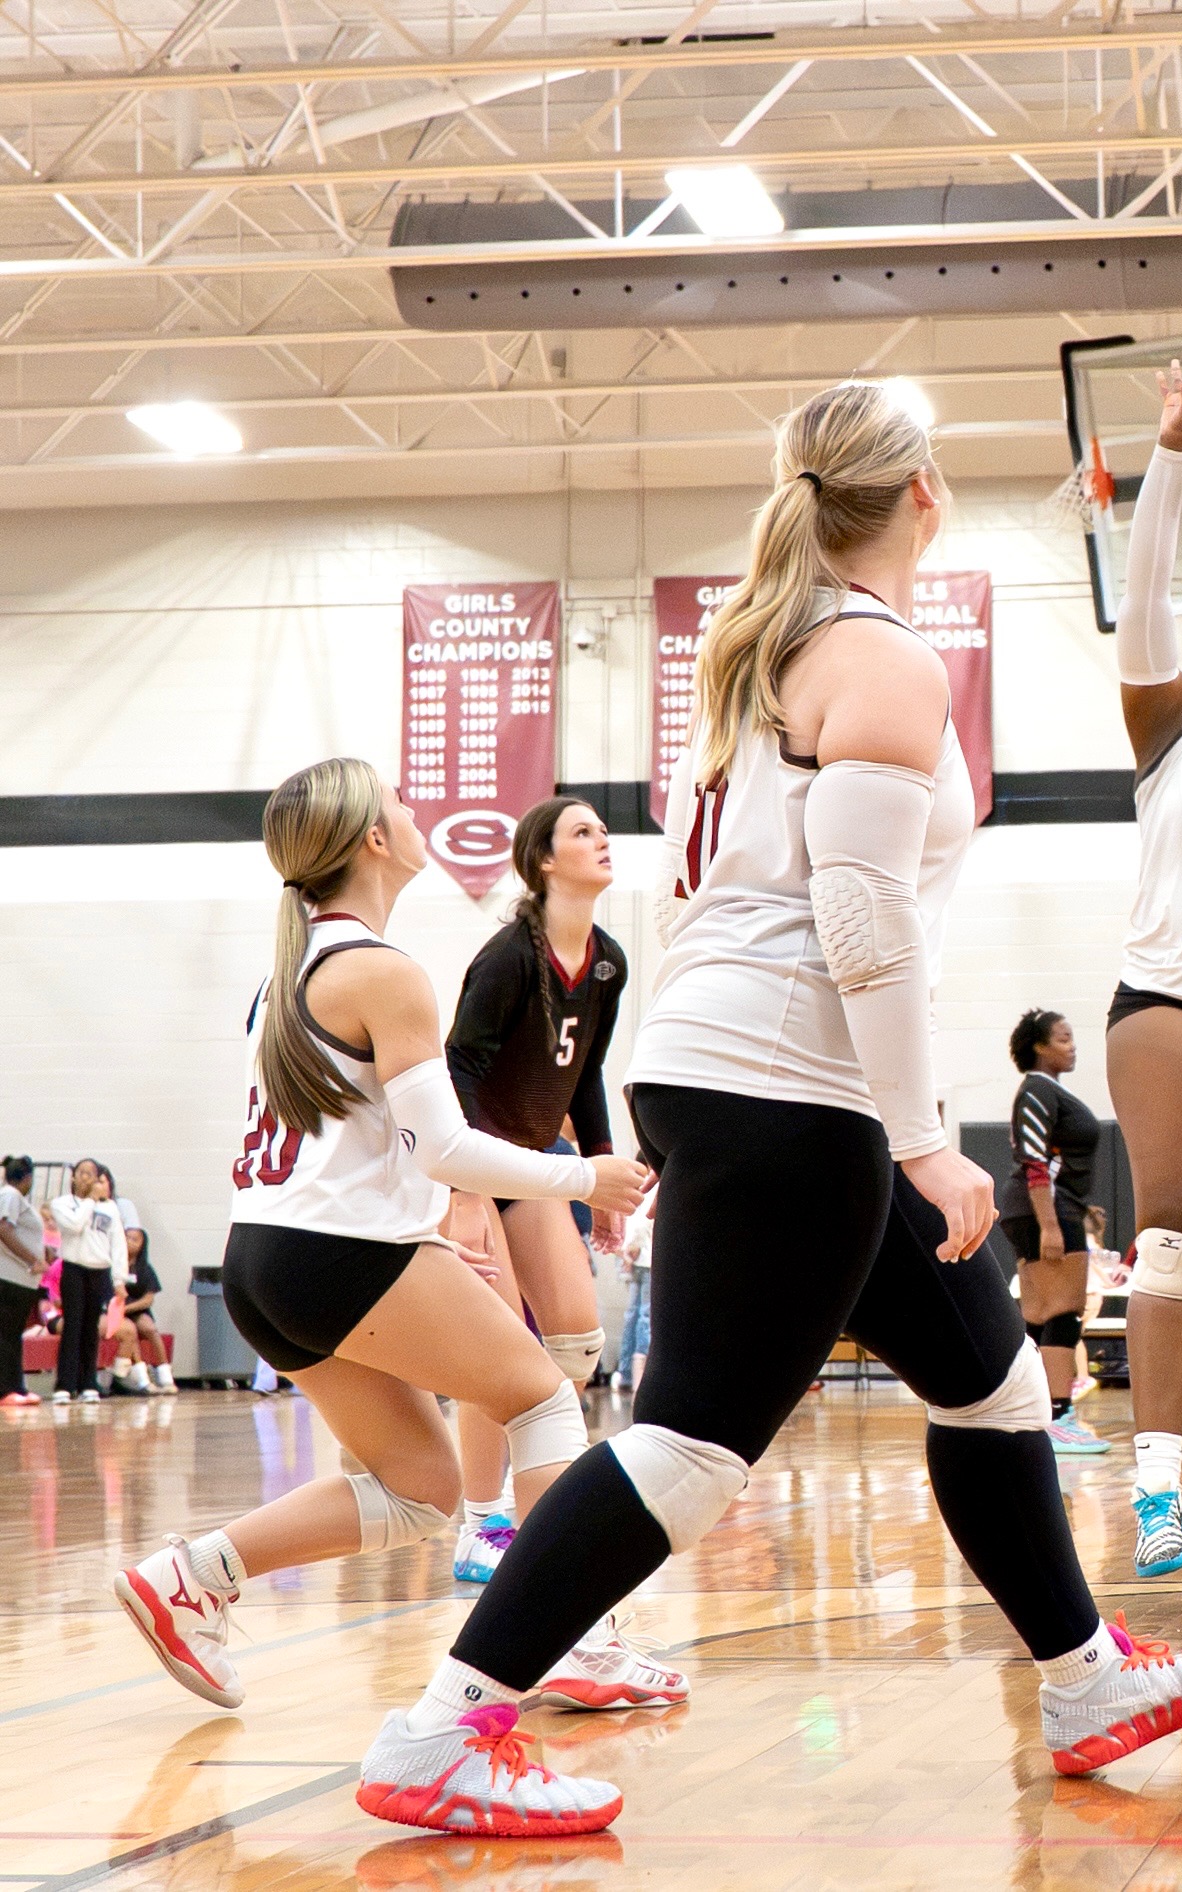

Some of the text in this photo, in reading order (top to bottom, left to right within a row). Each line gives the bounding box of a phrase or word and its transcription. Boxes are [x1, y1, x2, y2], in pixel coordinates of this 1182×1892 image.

[444, 592, 516, 614] GIRLS
[429, 617, 531, 638] COUNTY
[407, 640, 554, 664] CHAMPIONS
[512, 667, 550, 681] 2013
[511, 684, 550, 698] 2014
[511, 700, 550, 715] 2015
[458, 751, 496, 766] 2001
[458, 767, 497, 782] 2004
[556, 1017, 578, 1067] 5
[232, 1085, 305, 1191] 20
